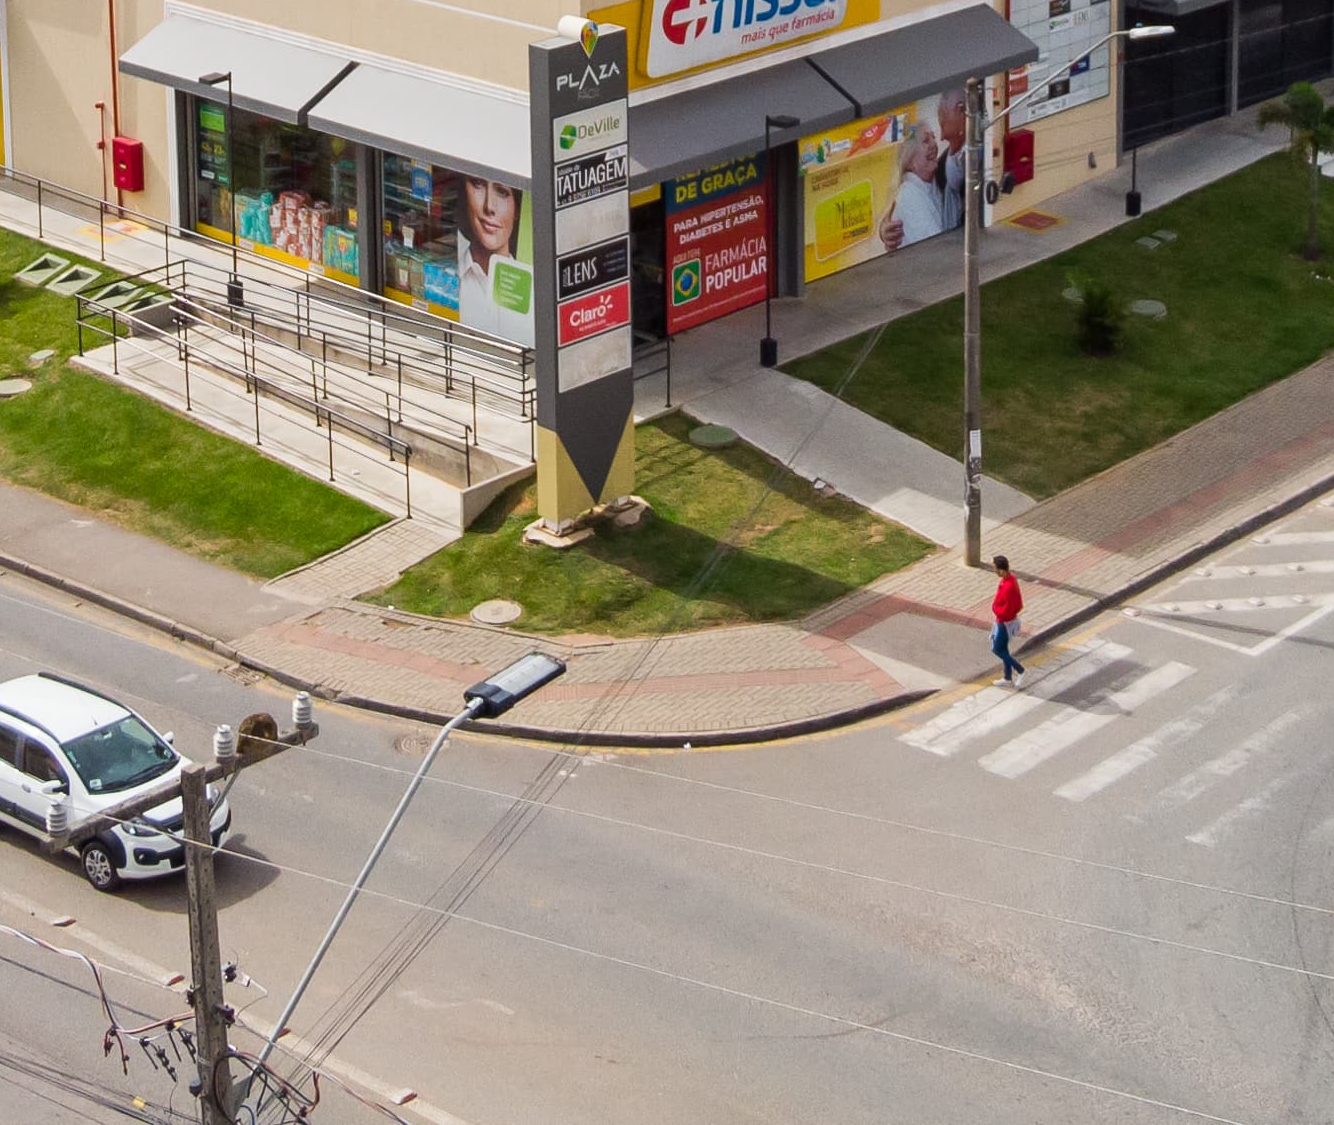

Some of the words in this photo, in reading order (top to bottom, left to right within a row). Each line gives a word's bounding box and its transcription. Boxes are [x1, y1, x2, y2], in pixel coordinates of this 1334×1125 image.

[741, 26, 766, 44] mais
[768, 22, 789, 40] que
[791, 8, 835, 30] farmácia
[556, 61, 620, 92] PLAZA
[578, 116, 620, 140] DeVille
[557, 156, 627, 197] TATUAGEM
[675, 181, 698, 204] DE
[701, 162, 757, 195] GRAÇA
[673, 217, 698, 233] PARA
[679, 223, 724, 245] DIABETES
[725, 219, 731, 229] E
[733, 209, 758, 226] ASMA
[705, 235, 767, 272] FARMÁCIA
[568, 257, 598, 287] LENS
[706, 255, 767, 294] POPULAR
[569, 304, 607, 327] Claro
